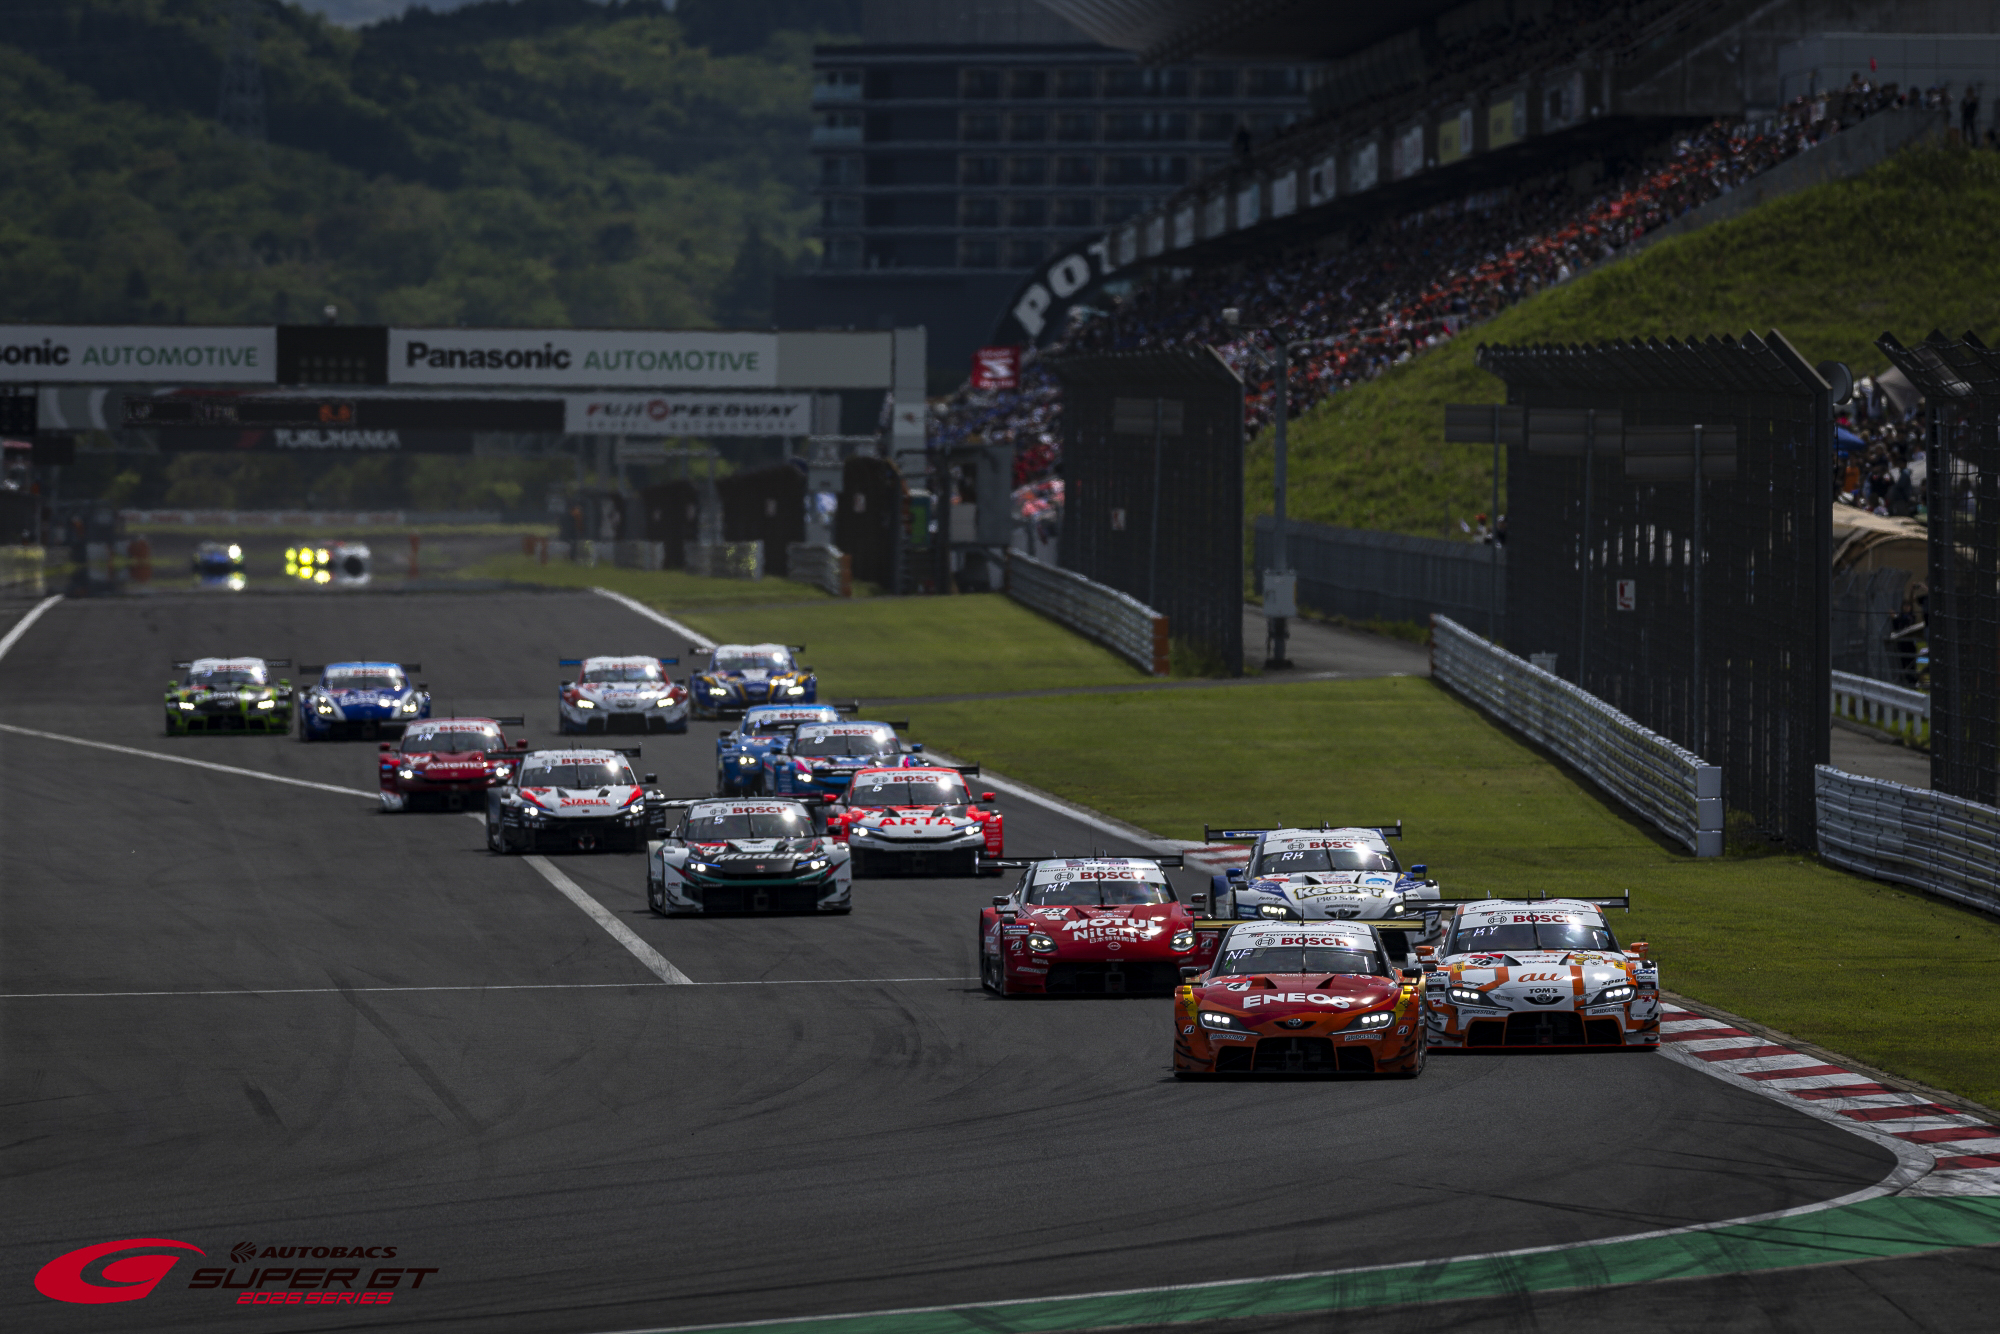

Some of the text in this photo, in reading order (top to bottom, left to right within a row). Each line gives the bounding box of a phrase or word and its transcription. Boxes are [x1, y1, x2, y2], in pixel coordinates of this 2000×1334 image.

[0, 338, 259, 367] onic AUTOMOTIVE
[406, 341, 759, 371] Panasonic AUTOMOTIVE
[879, 817, 956, 827] ARTA
[1294, 885, 1385, 900] KeePer
[1062, 918, 1163, 931] MOTUL
[1513, 915, 1577, 923] BOSC
[1073, 927, 1153, 941] Niterra
[1280, 937, 1350, 947] BOSCH
[1518, 972, 1564, 983] au
[1602, 977, 1632, 986] spark
[1243, 993, 1350, 1009] ENEOS
